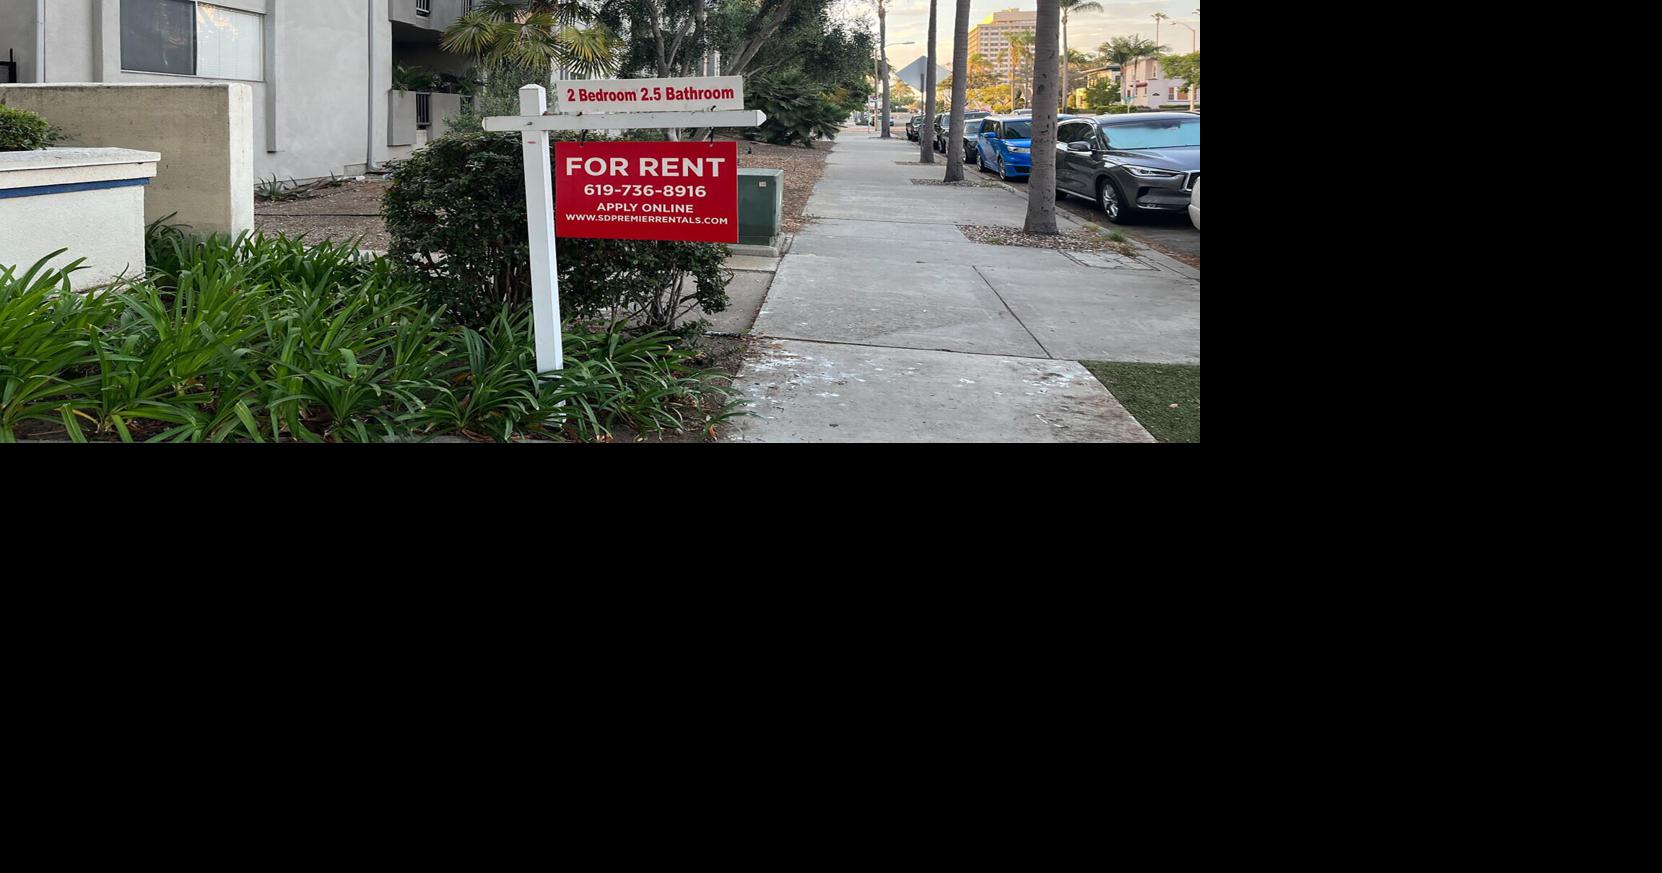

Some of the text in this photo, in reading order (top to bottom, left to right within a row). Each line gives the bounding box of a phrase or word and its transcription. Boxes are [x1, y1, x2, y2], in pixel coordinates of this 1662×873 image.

[567, 86, 734, 102] 2 Bedroom 2.5 Bathroom
[565, 157, 726, 177] FOR RENT
[583, 184, 707, 198] 619-736-8916
[596, 203, 694, 214] APPLY ONLINE
[565, 214, 728, 225] WWW.SDPREMIERRENTALS.COM
